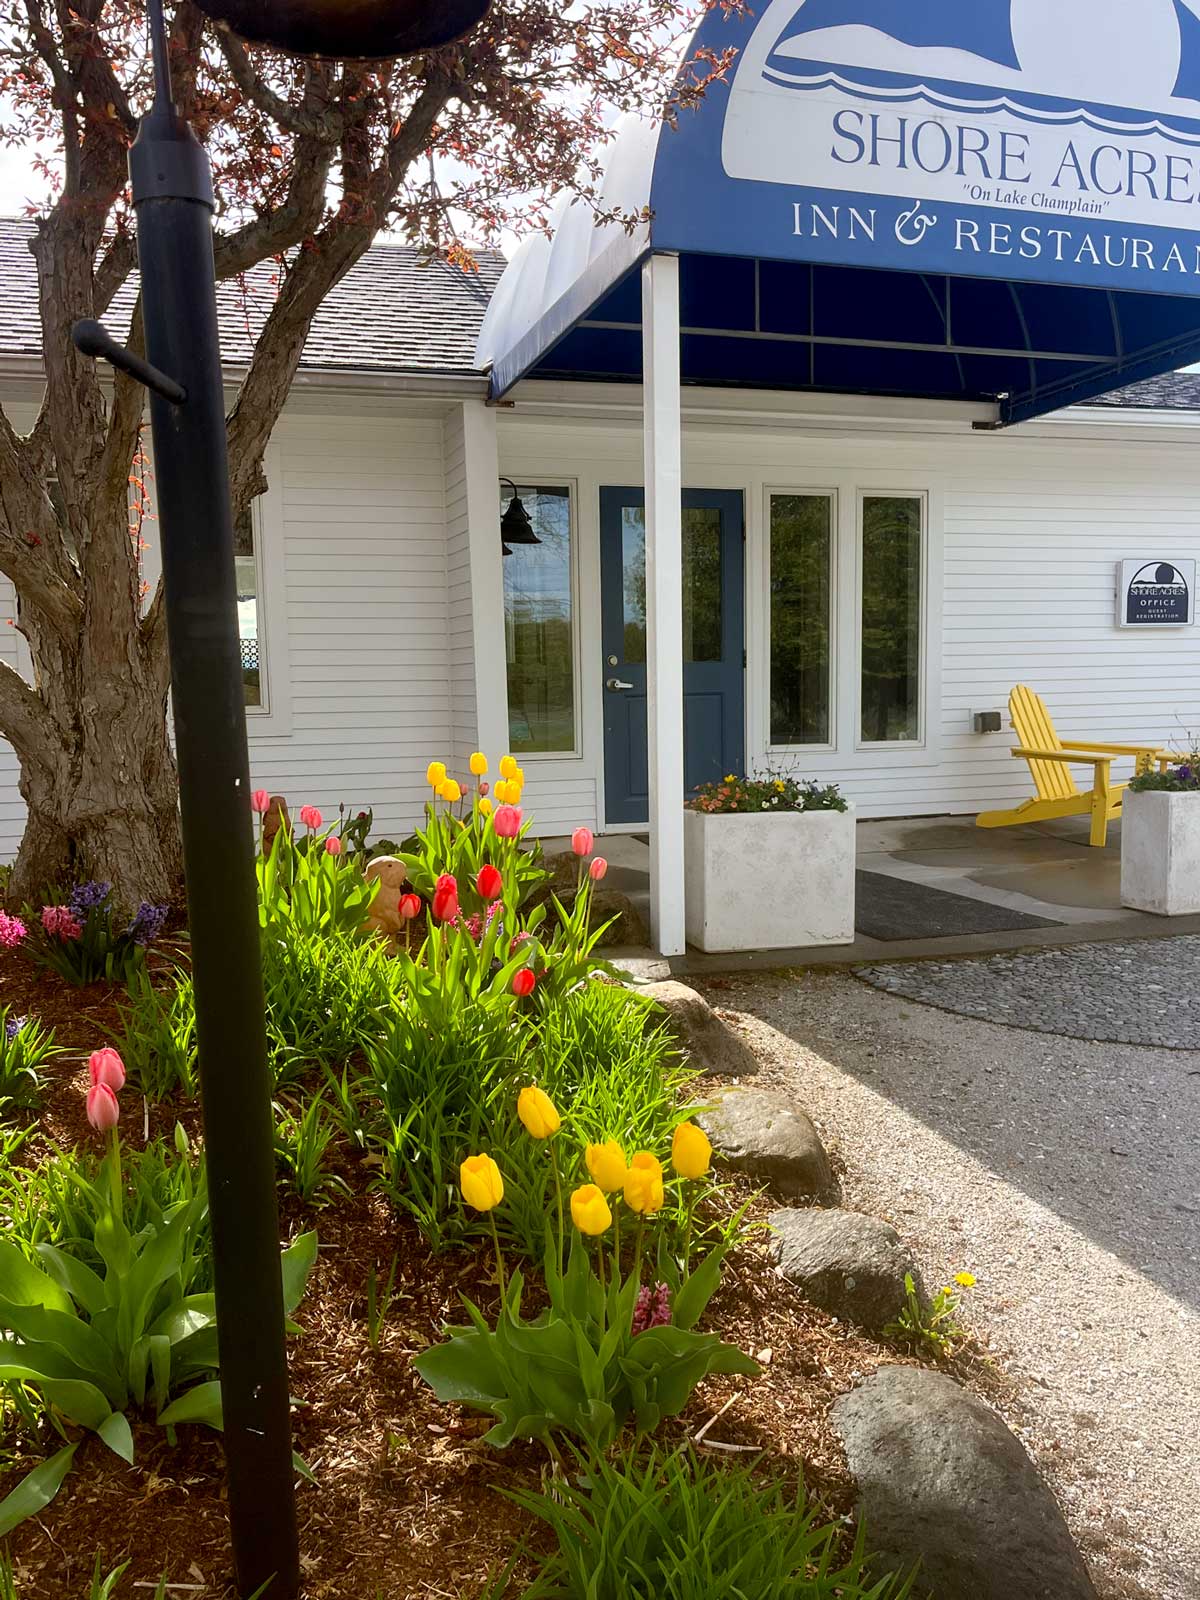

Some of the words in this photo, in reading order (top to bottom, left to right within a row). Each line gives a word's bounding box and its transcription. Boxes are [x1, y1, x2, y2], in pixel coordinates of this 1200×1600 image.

[830, 109, 1032, 184] SHORE
[1050, 139, 1200, 204] ACRE
[962, 183, 990, 201] "On
[994, 187, 1027, 206] Lake
[1031, 192, 1110, 215] Champlain"
[791, 202, 876, 242] INN
[894, 199, 937, 246] &
[953, 217, 1200, 275] RESTAURA
[1130, 588, 1158, 596] SHORE
[1159, 588, 1185, 596] ACRES
